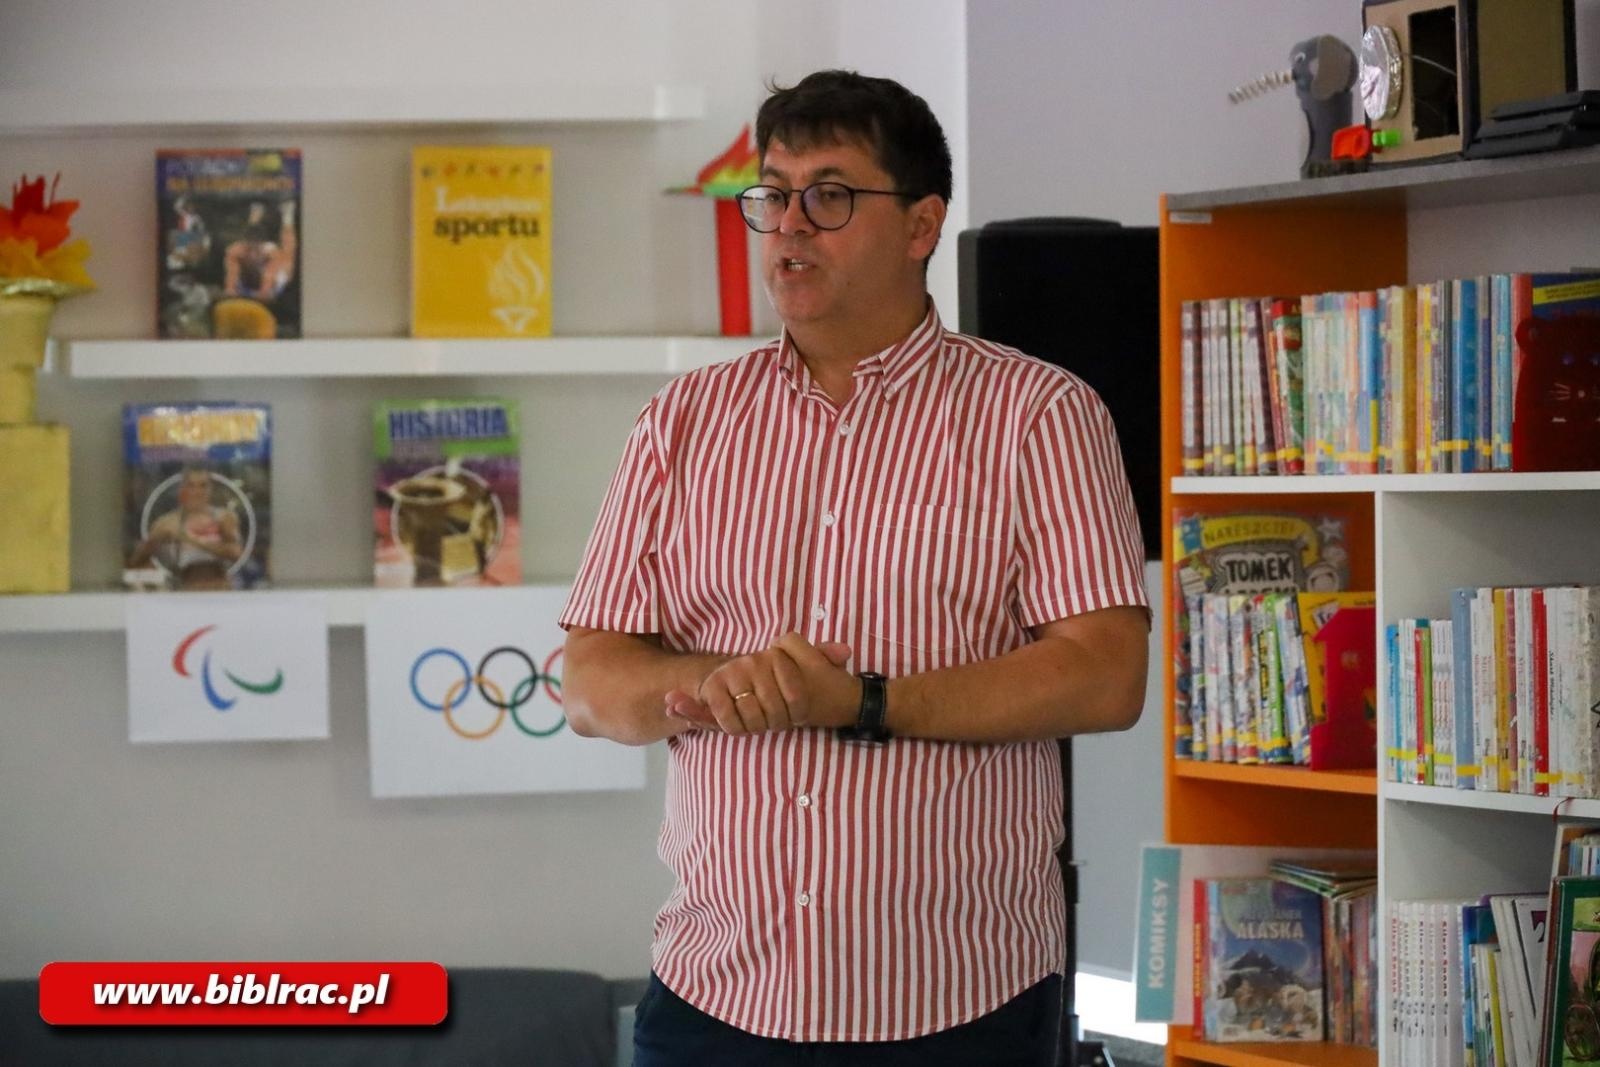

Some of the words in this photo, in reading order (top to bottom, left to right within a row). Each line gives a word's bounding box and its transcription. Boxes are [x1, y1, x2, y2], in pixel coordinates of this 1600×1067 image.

[434, 215, 540, 244] sportu
[389, 406, 509, 438] HISTORIA
[1225, 556, 1293, 583] TOMEK
[1147, 879, 1170, 989] KOMIKSY
[1236, 921, 1305, 940] ALASKA
